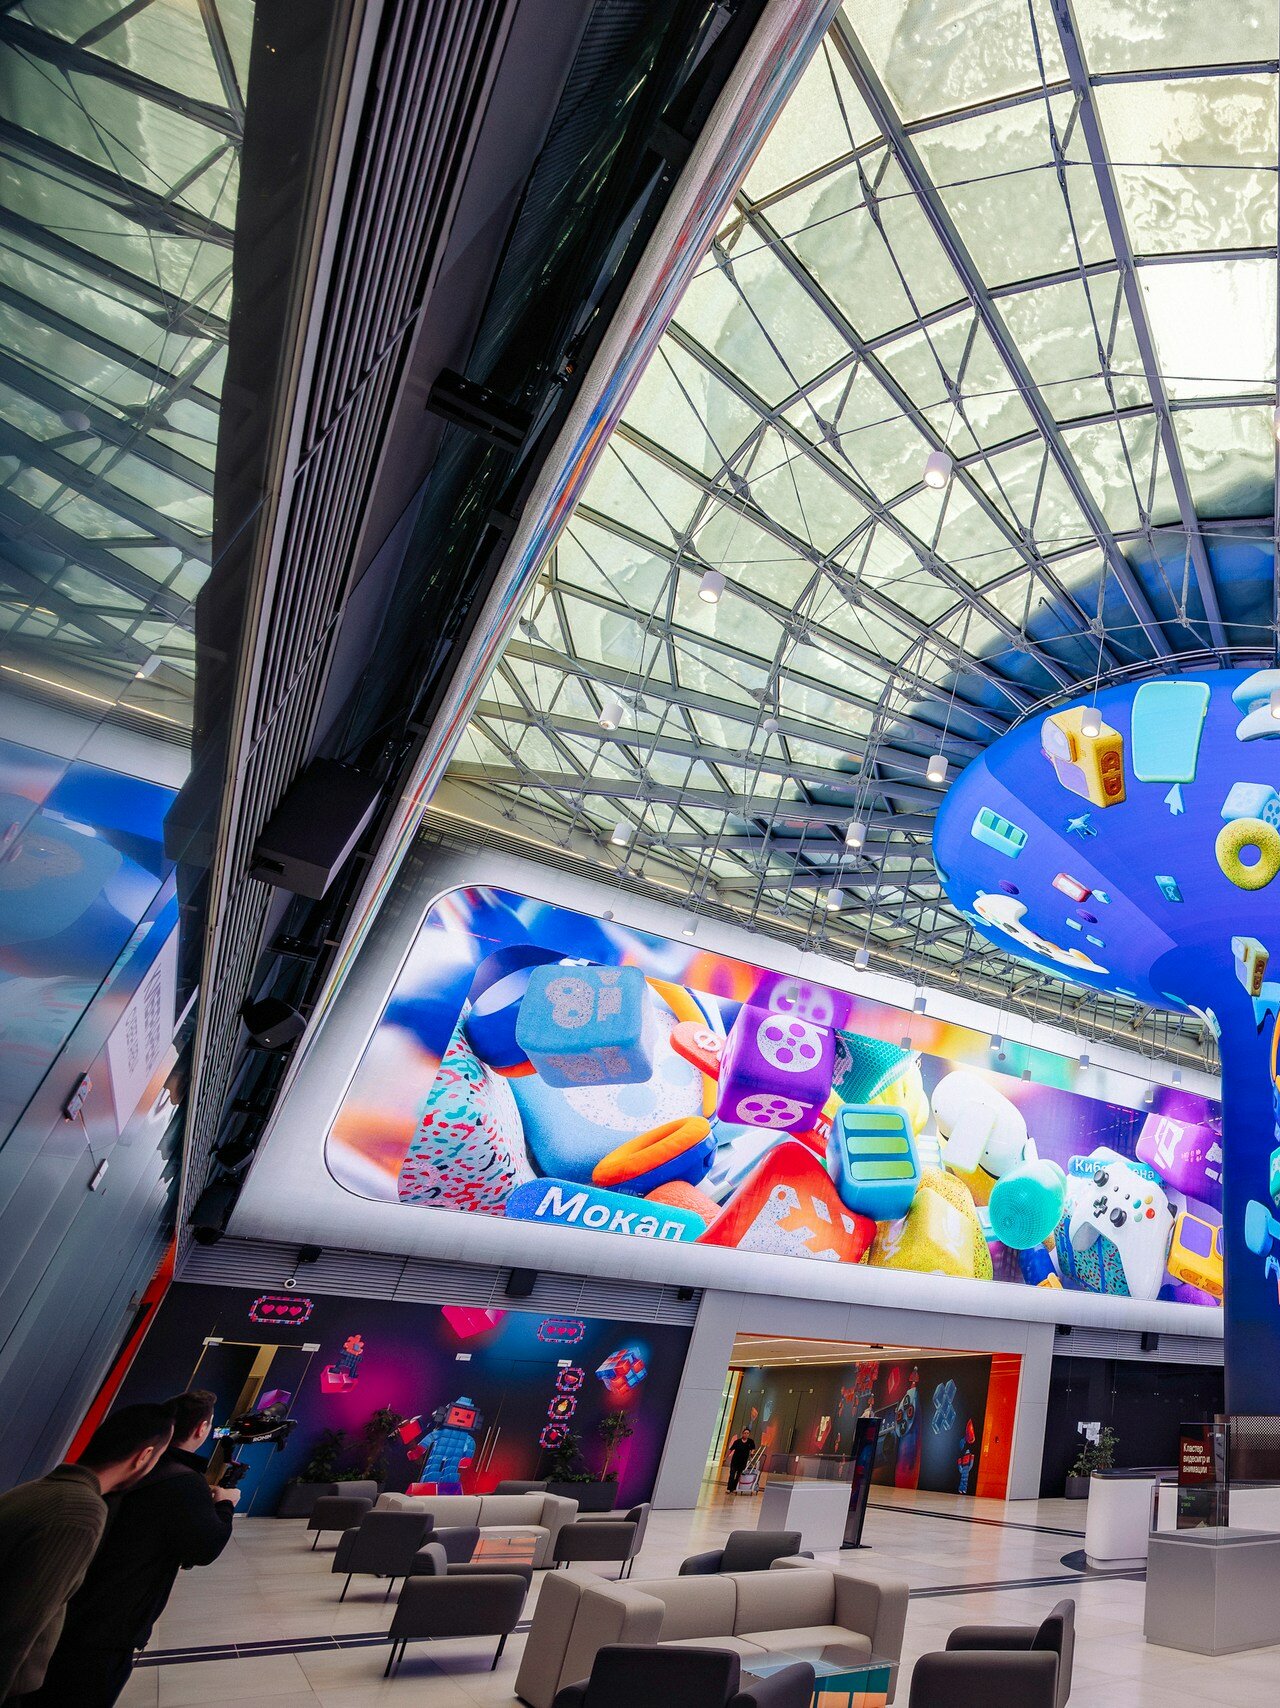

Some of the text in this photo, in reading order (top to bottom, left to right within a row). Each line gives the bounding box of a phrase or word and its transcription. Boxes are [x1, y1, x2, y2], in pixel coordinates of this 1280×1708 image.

[534, 1186, 686, 1241] Мокап
[1183, 1443, 1203, 1454] Кластер
[1183, 1455, 1205, 1465] видеоигр
